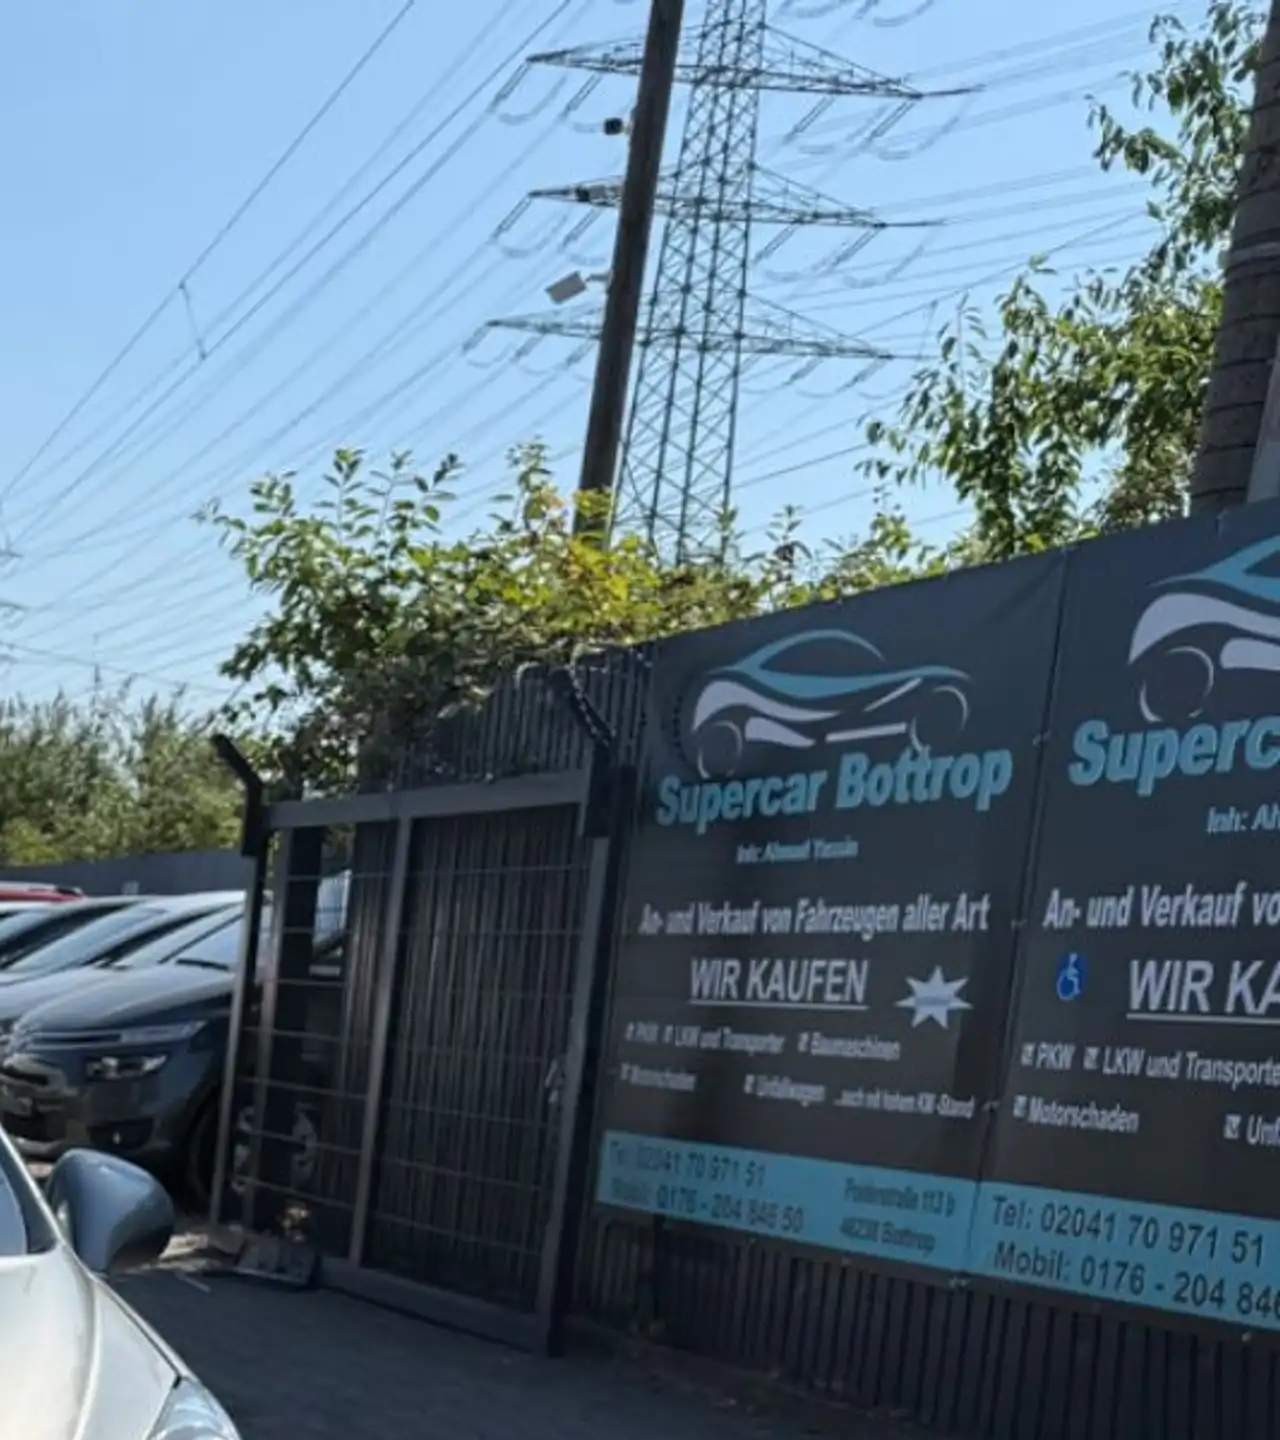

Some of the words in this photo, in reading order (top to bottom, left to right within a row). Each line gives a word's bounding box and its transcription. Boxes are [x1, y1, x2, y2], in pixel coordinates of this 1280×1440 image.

[657, 769, 827, 834] Supercar
[835, 747, 1013, 810] Bottrop
[697, 899, 761, 935] Verkauf
[762, 907, 793, 935] von
[794, 897, 899, 942] Fahrzeugen
[903, 892, 951, 933] aller
[950, 892, 991, 932] Art
[1086, 885, 1135, 928] und
[1140, 880, 1248, 929] Verkauf
[690, 958, 742, 1000] WIR
[745, 958, 870, 1004] KAUFEN
[1129, 960, 1215, 1013] WIR
[1036, 1041, 1076, 1070] PKW
[1102, 1045, 1146, 1076] LKW
[1145, 1051, 1181, 1079] und
[1028, 1096, 1140, 1135] Motorschaden
[744, 1159, 767, 1189] 51
[780, 1204, 805, 1234] 50
[993, 1195, 1033, 1231] Tel:
[1040, 1202, 1117, 1243] 02041
[1128, 1213, 1160, 1250] 70
[1168, 1221, 1218, 1260] 971
[1230, 1229, 1264, 1268] 51
[993, 1240, 1071, 1283] Mobil:
[1079, 1255, 1146, 1297] 0176
[1172, 1271, 1226, 1310] 204
